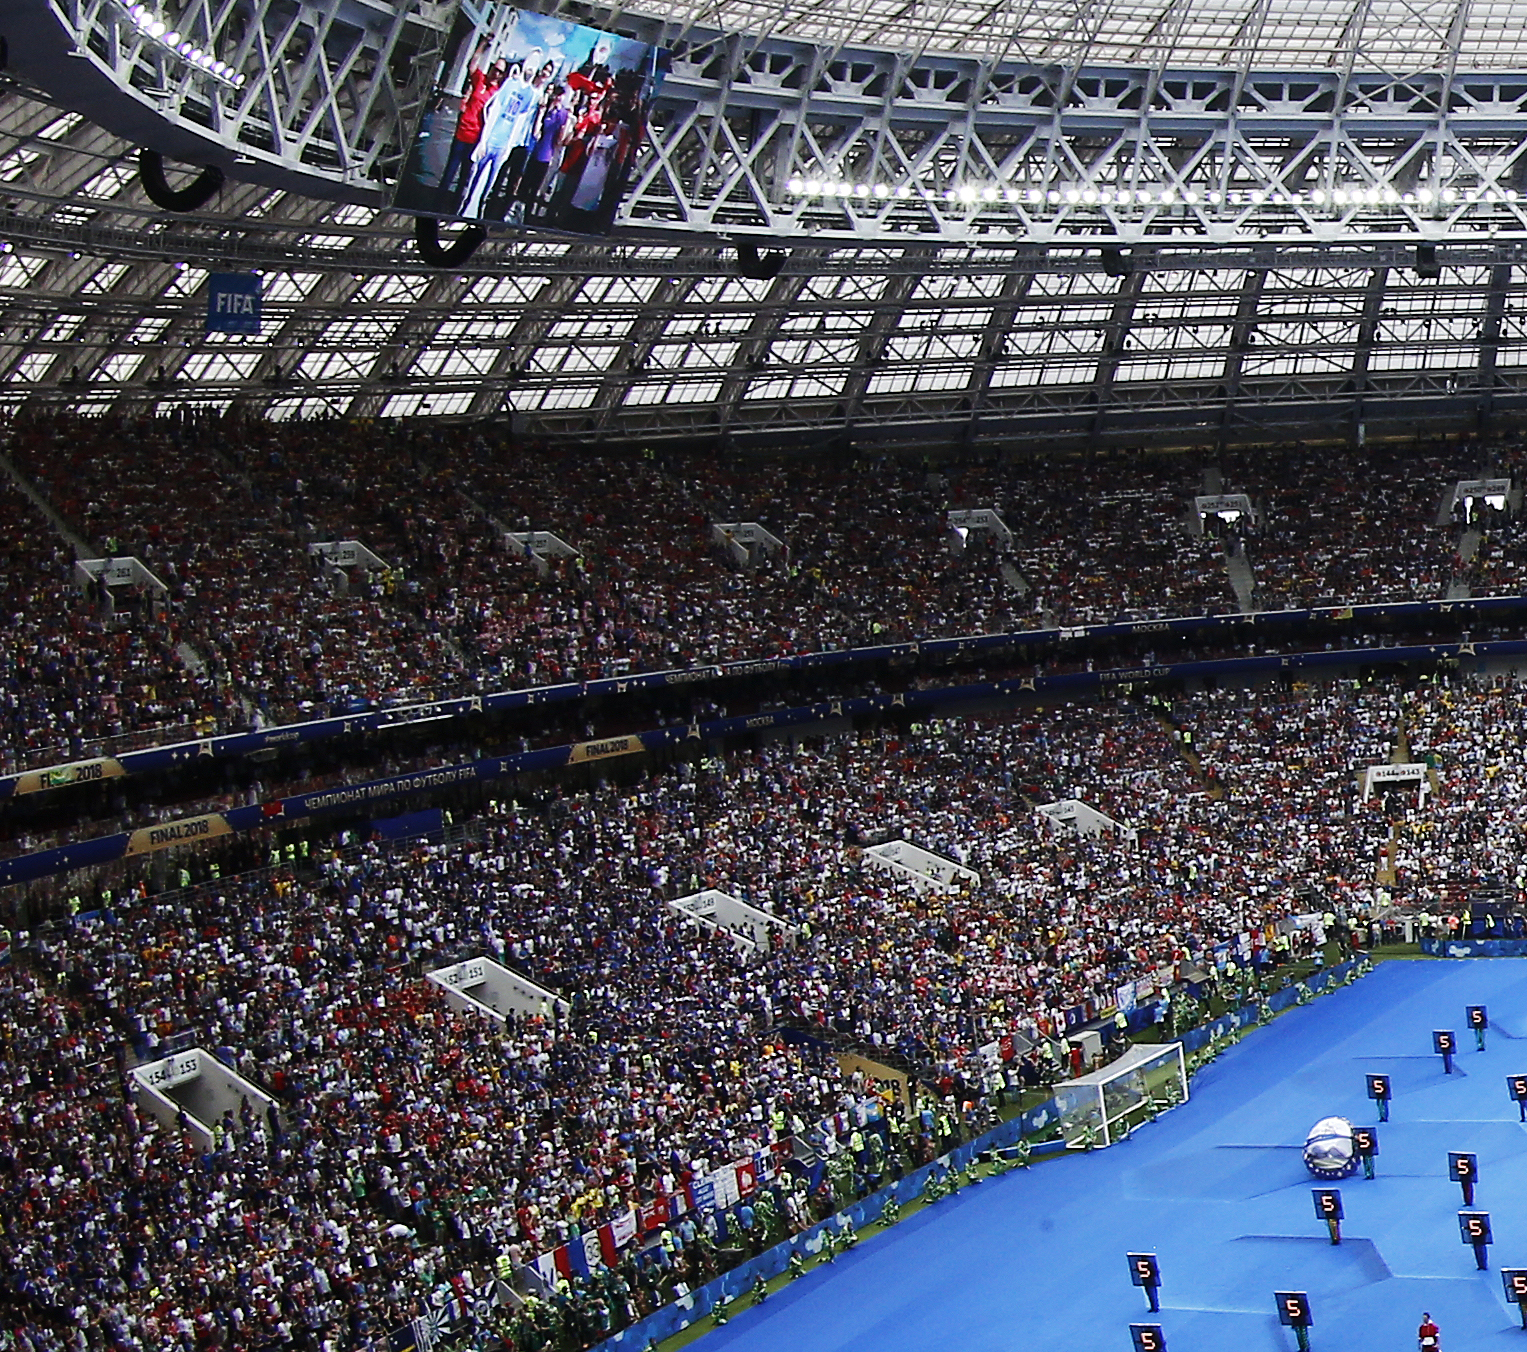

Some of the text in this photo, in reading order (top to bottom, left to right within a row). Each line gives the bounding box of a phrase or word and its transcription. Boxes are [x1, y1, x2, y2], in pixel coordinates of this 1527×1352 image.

[217, 292, 256, 314] FIFA
[1100, 667, 1171, 681] FIFA WORLD CUP
[586, 739, 629, 757] FINAL 2018
[77, 763, 102, 780] 2018
[304, 767, 477, 809] ЧЕМПИОНАТ МИРА ПО ФУТБОЛУ FIFA
[151, 820, 209, 845] FINAL 2018
[469, 966, 483, 978] 151
[1440, 1036, 1449, 1048] 5
[180, 1059, 197, 1075] 153
[1322, 1196, 1334, 1211] 5
[1469, 1220, 1481, 1235] 5
[1141, 1333, 1155, 1349] 5
